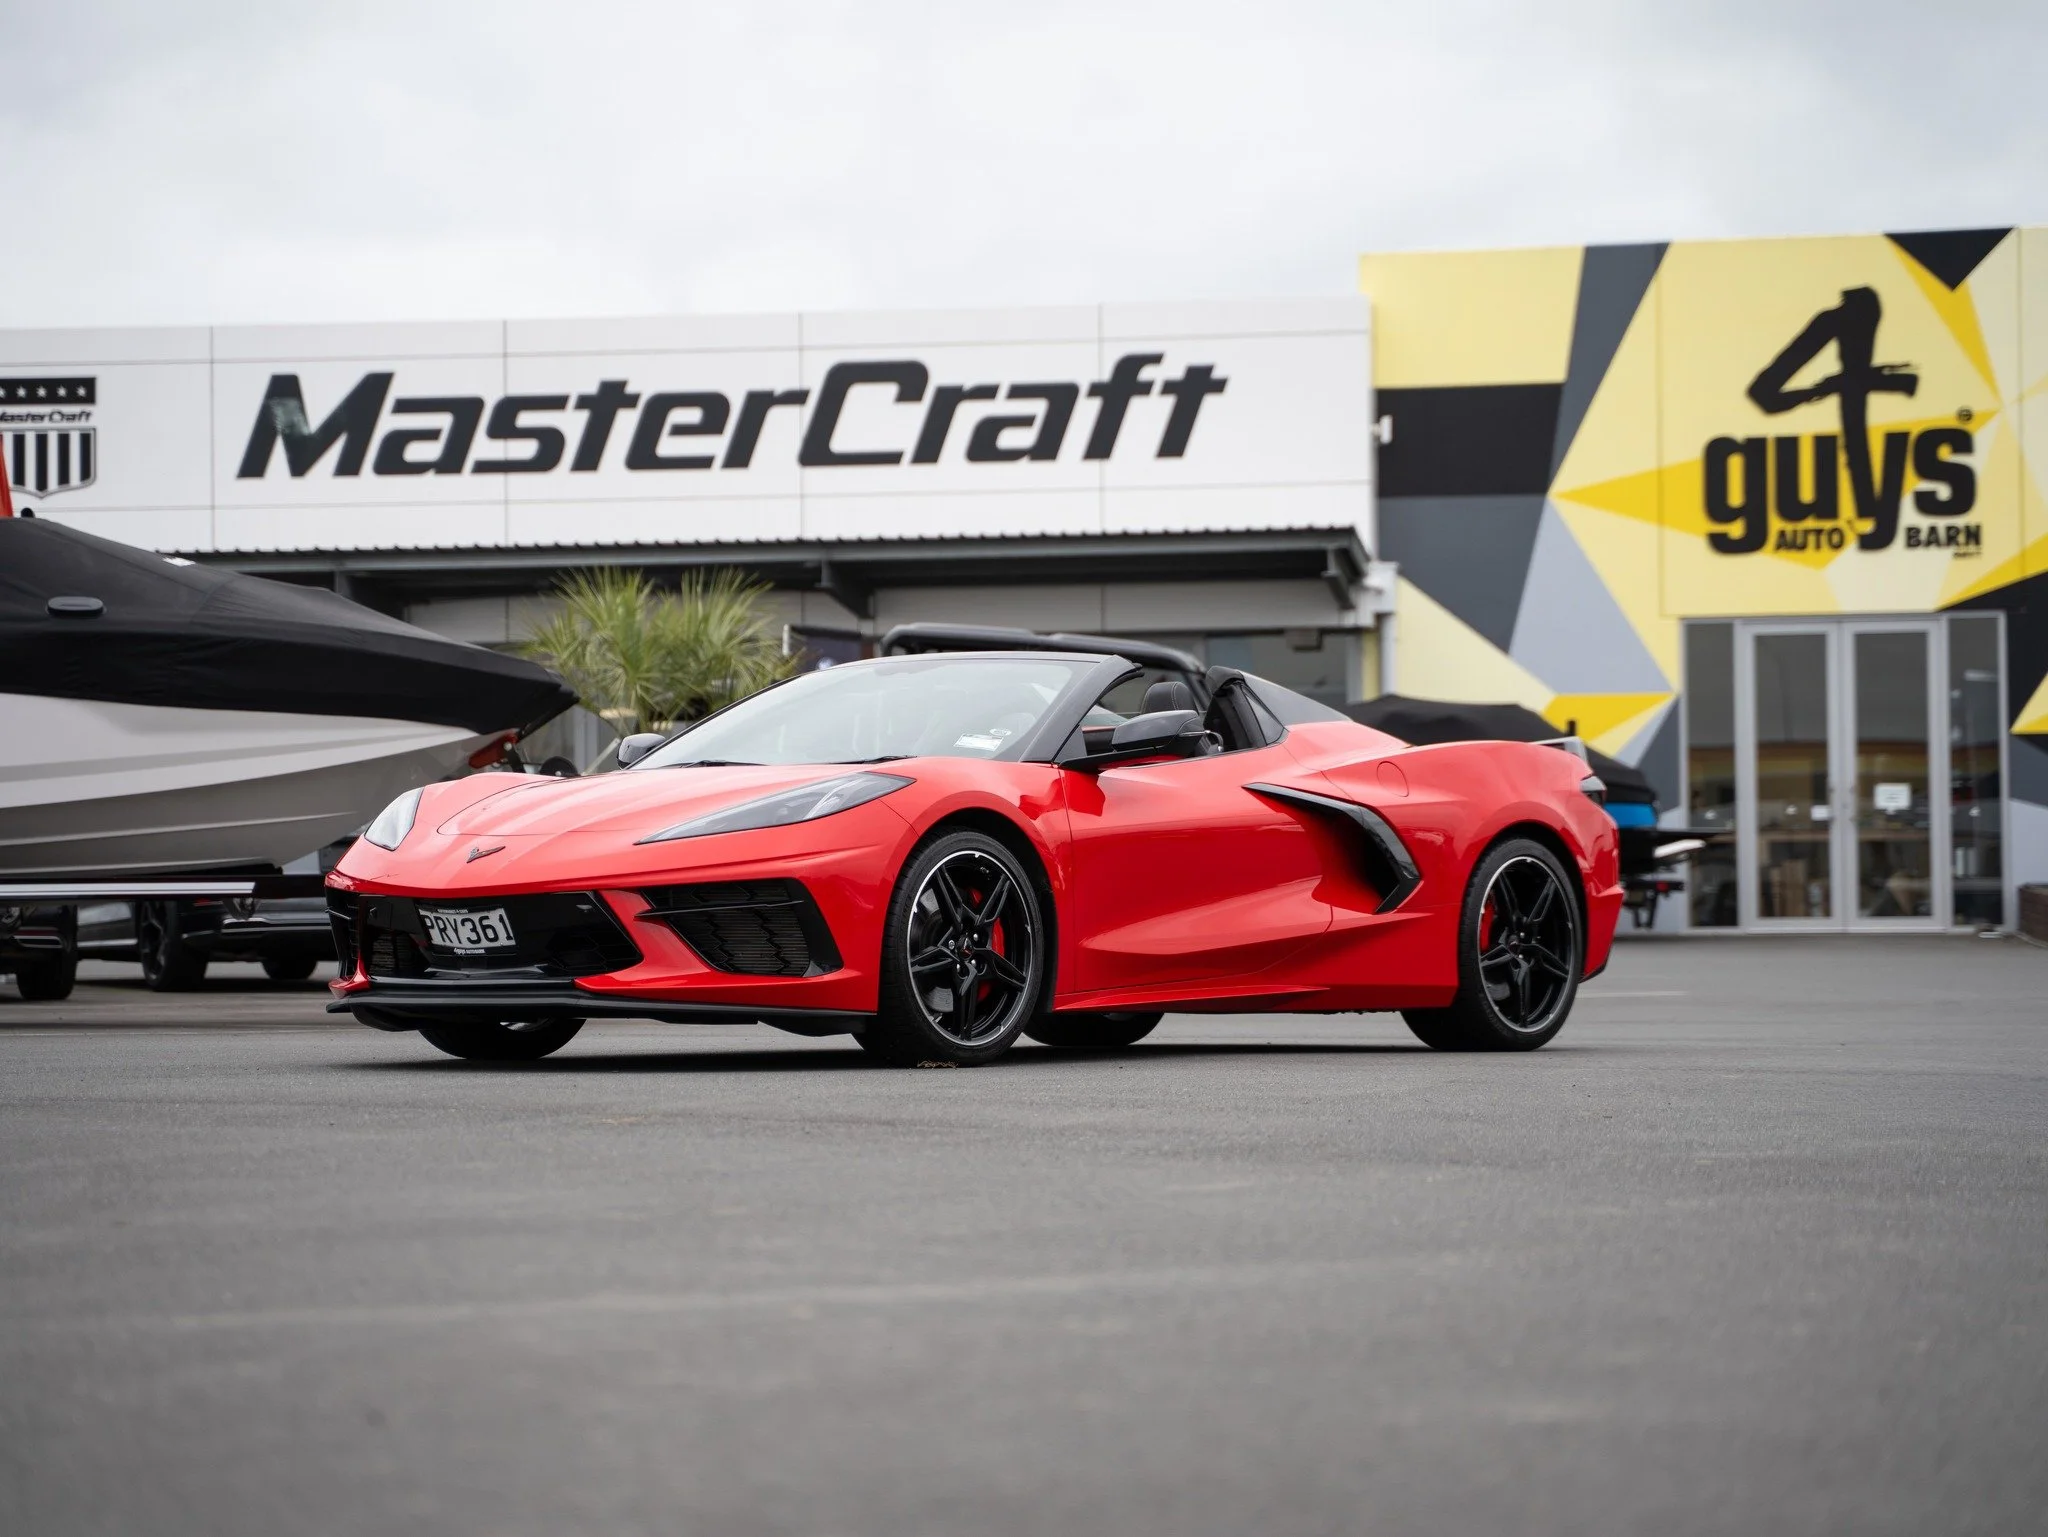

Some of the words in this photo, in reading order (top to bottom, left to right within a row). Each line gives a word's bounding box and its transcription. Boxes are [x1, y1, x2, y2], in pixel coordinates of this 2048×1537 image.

[237, 352, 1228, 479] MasterCraft
[1746, 286, 1918, 430] 4
[1704, 427, 1977, 555] guys
[1774, 528, 1846, 552] AUTO
[1905, 524, 1982, 549] BARN
[420, 913, 513, 945] PRY361
